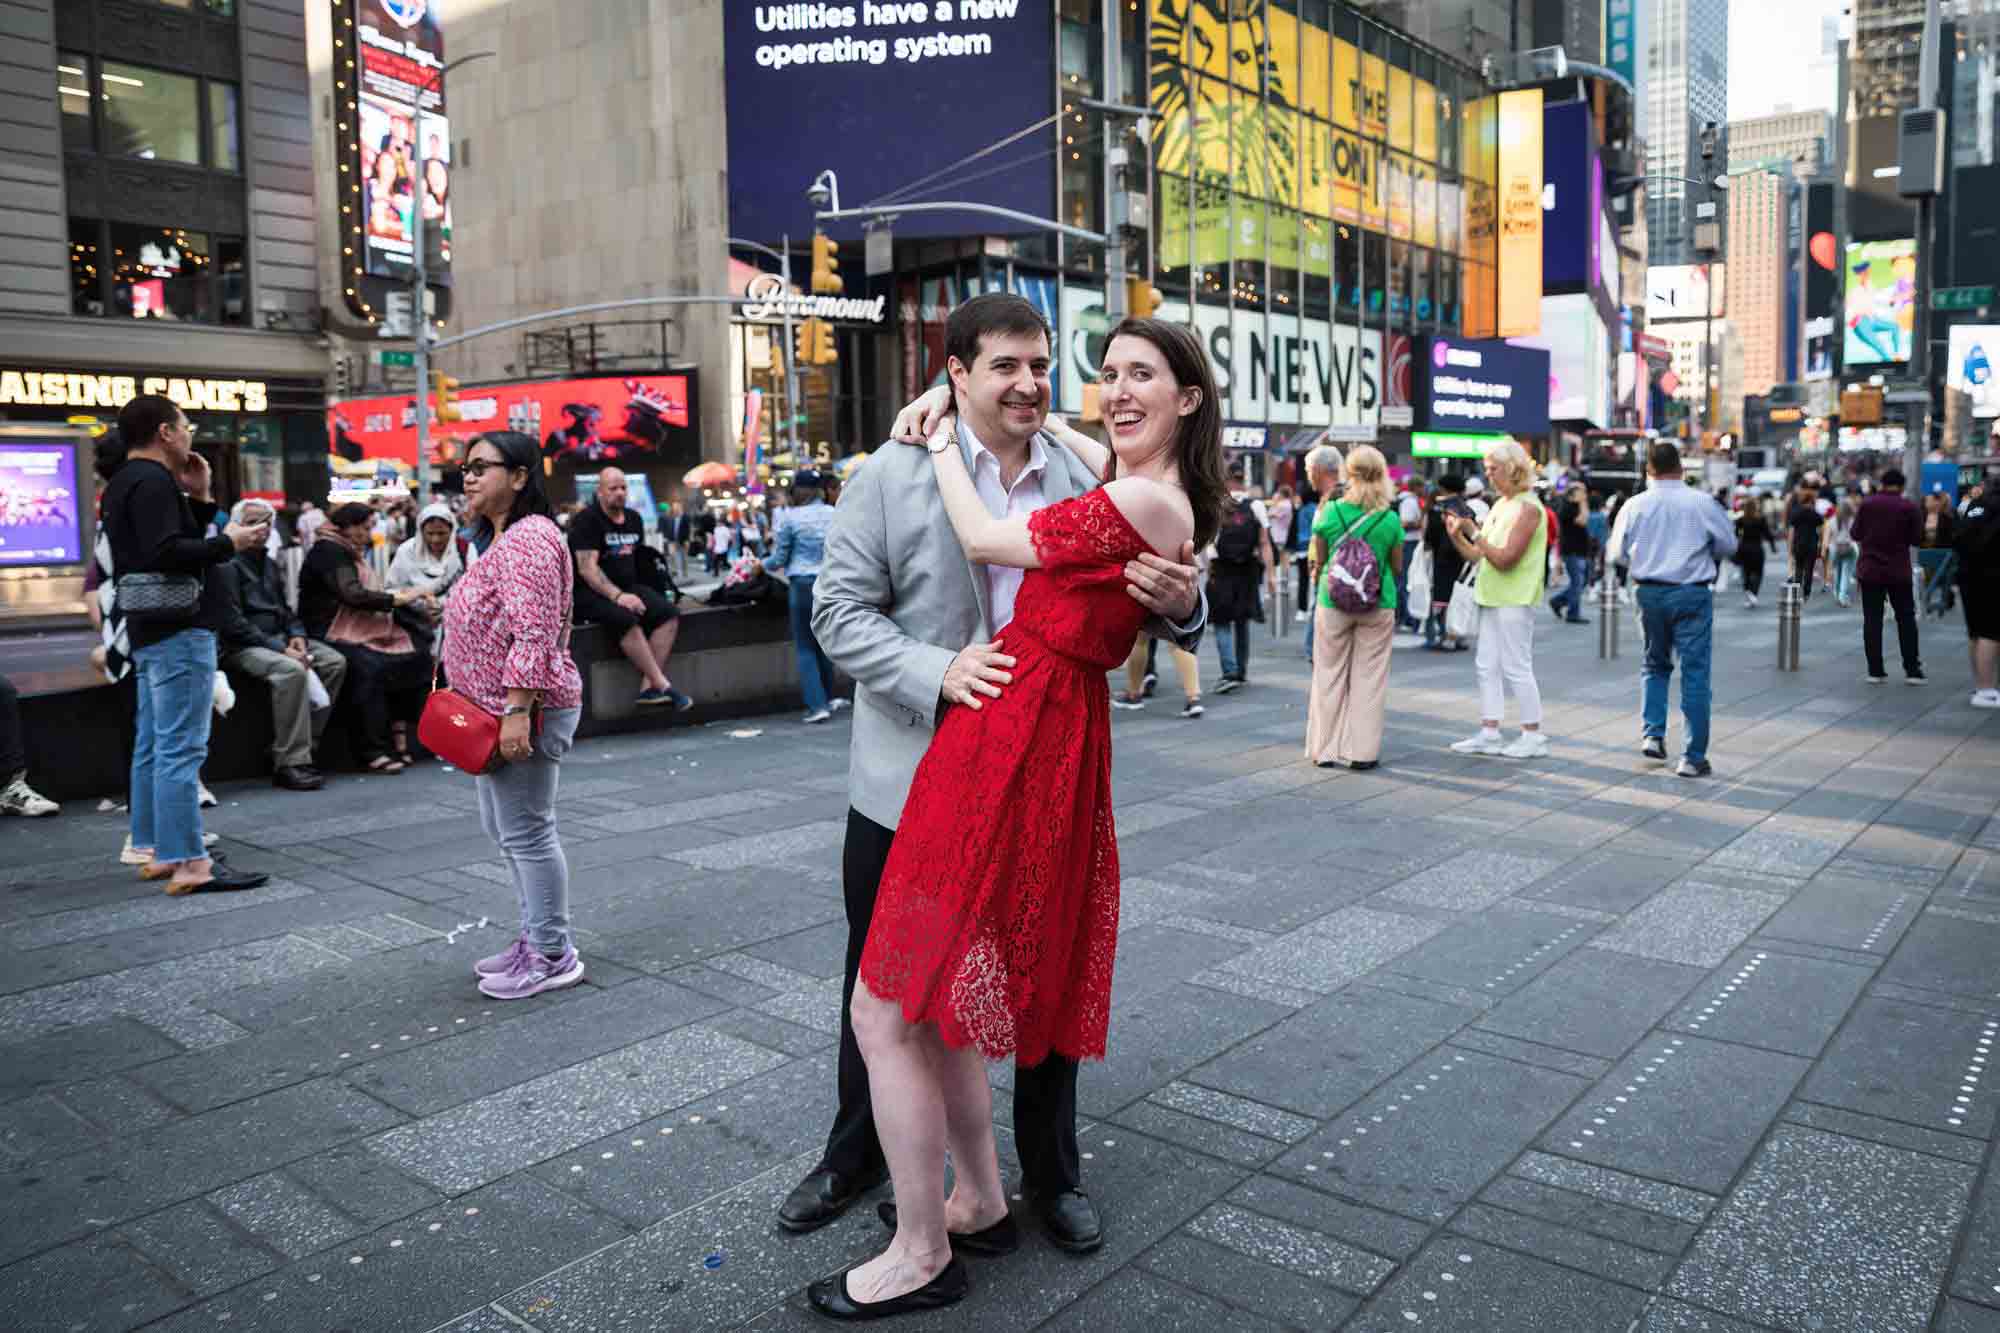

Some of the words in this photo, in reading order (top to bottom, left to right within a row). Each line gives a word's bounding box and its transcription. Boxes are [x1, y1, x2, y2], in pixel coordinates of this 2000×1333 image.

[755, 3, 856, 31] Utilities
[863, 0, 928, 26] have
[935, 1, 952, 21] a
[960, 0, 1018, 20] new
[755, 36, 887, 69] operating
[894, 32, 992, 62] system
[1350, 80, 1387, 122] THE
[742, 273, 885, 322] Paramount
[1249, 331, 1377, 409] NEWS
